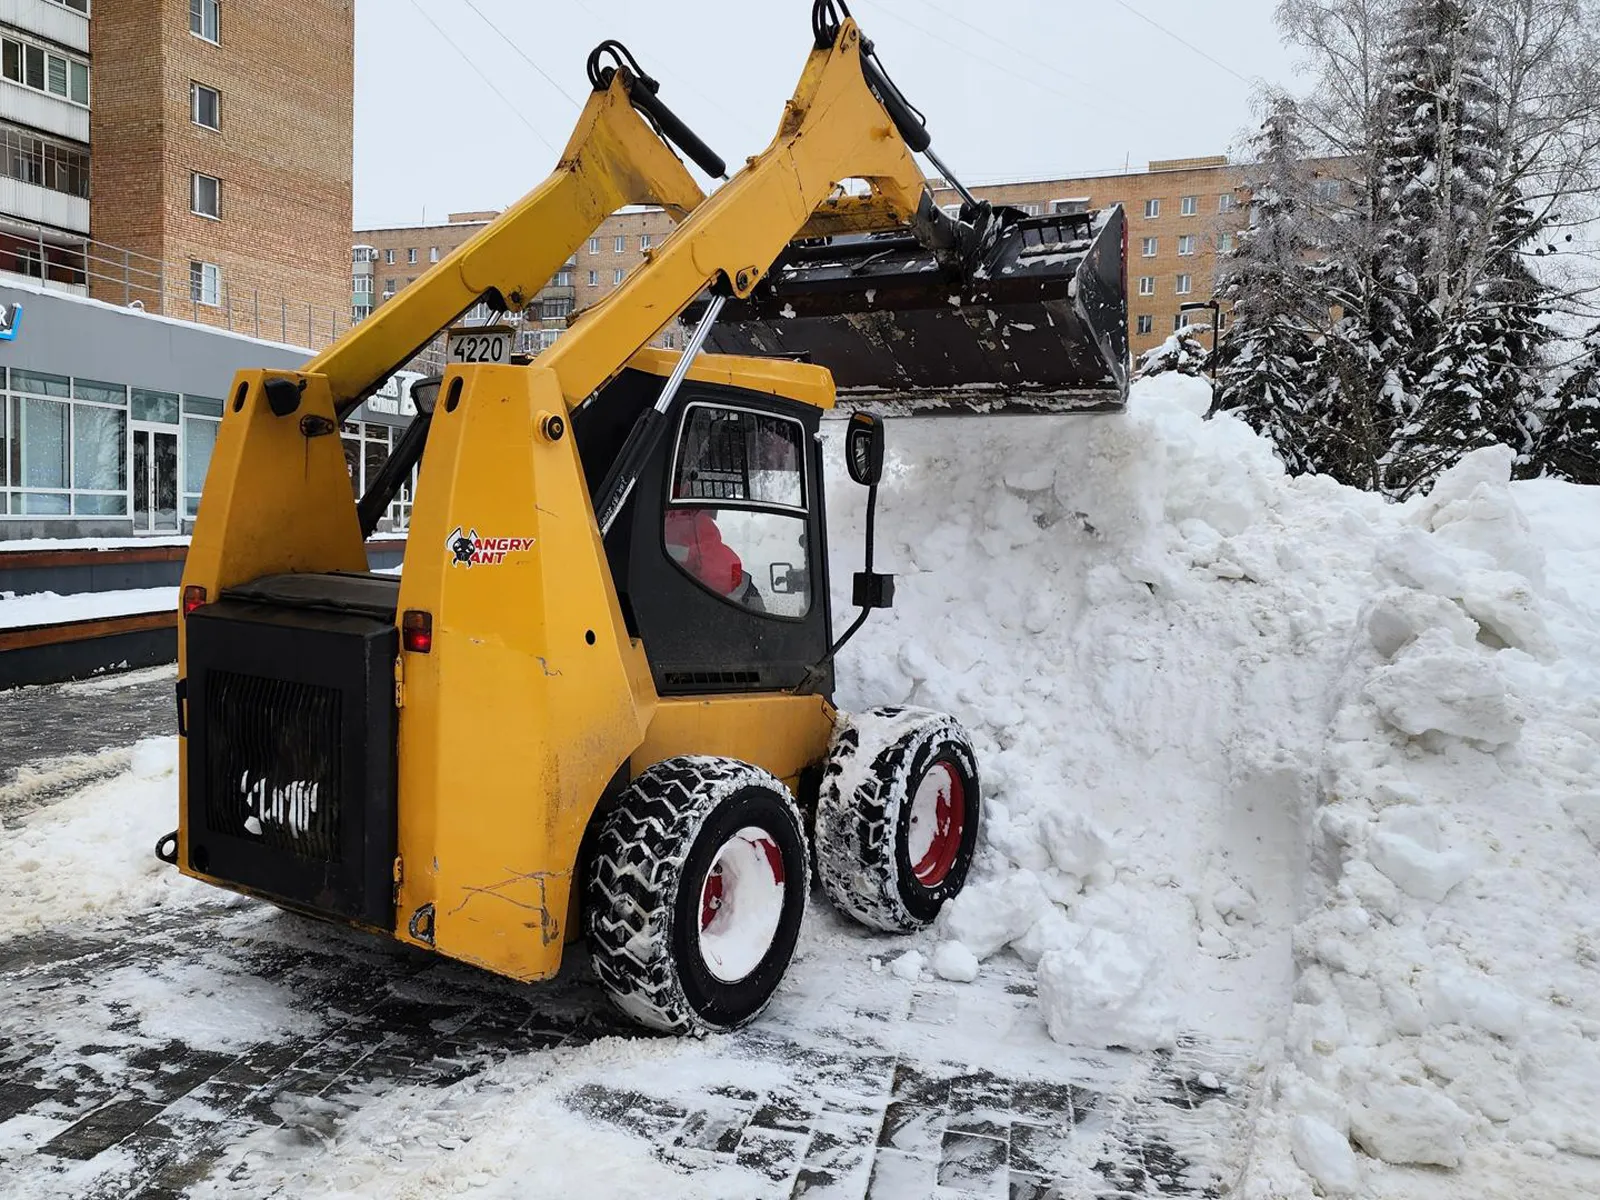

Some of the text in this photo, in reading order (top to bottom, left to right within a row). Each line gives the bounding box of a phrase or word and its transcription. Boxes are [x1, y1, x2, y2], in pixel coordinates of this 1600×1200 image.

[454, 337, 503, 363] 4220
[474, 538, 535, 552] ANGRY
[470, 551, 506, 564] ANT
